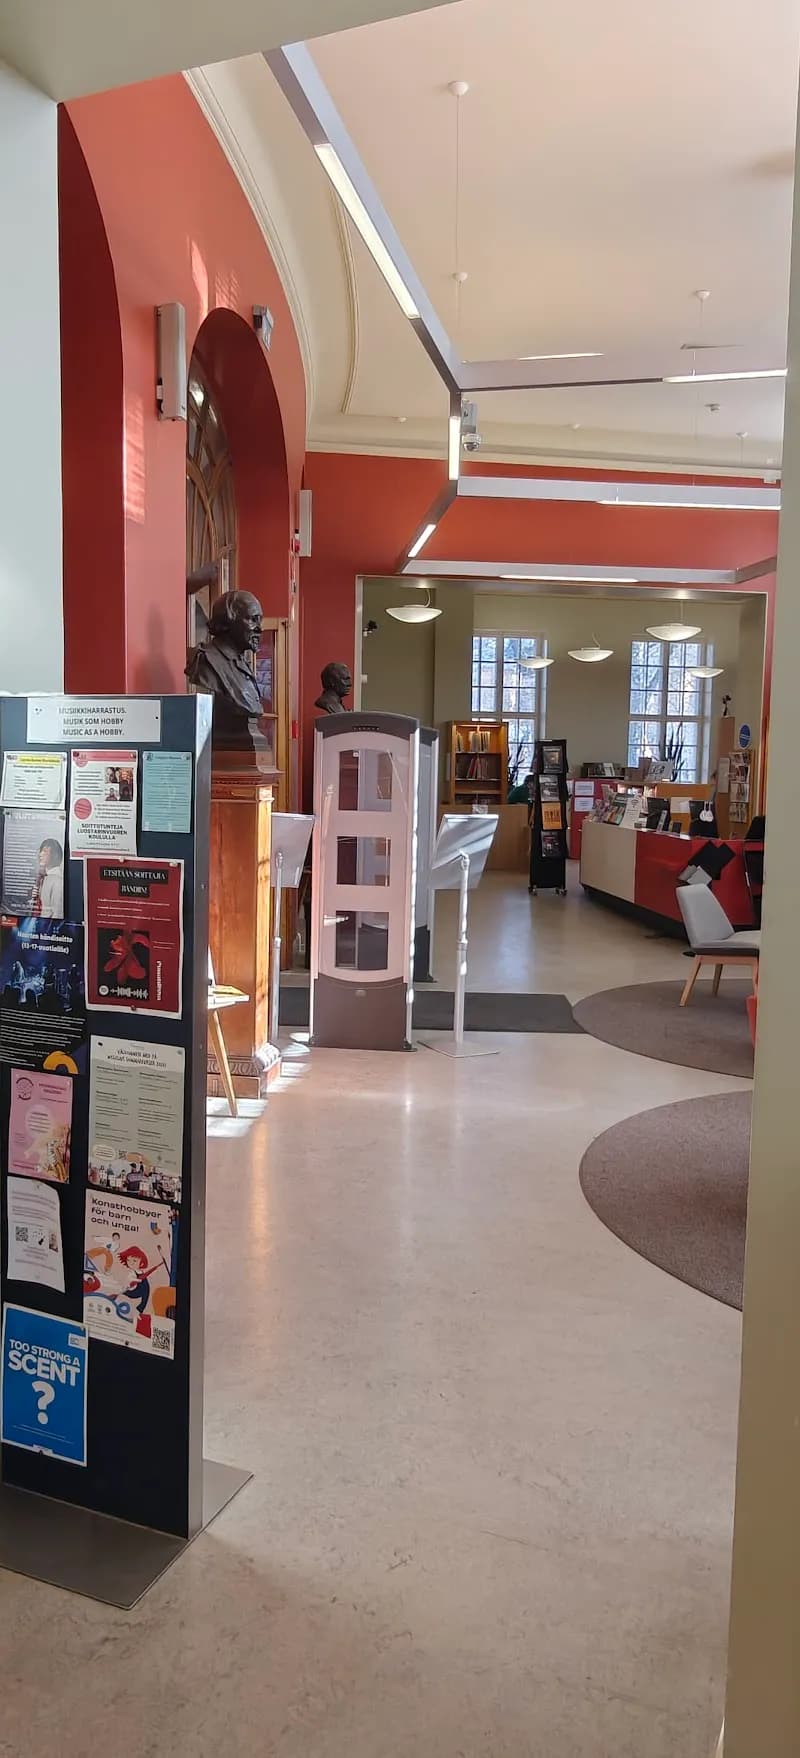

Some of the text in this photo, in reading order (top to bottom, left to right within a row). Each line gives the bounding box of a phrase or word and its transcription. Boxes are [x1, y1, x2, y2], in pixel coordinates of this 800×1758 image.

[58, 706, 127, 714] MUSIIKKIHARRASTUS.
[62, 728, 83, 736] MUSIC
[99, 728, 125, 736] HOBBY.
[91, 1196, 162, 1219] Konsthobbyer
[91, 1206, 131, 1222] för barn
[91, 1215, 139, 1233] och unga!
[9, 1338, 80, 1367] TOO STRONG A
[7, 1349, 81, 1387] SCENT
[31, 1381, 56, 1425] ?
